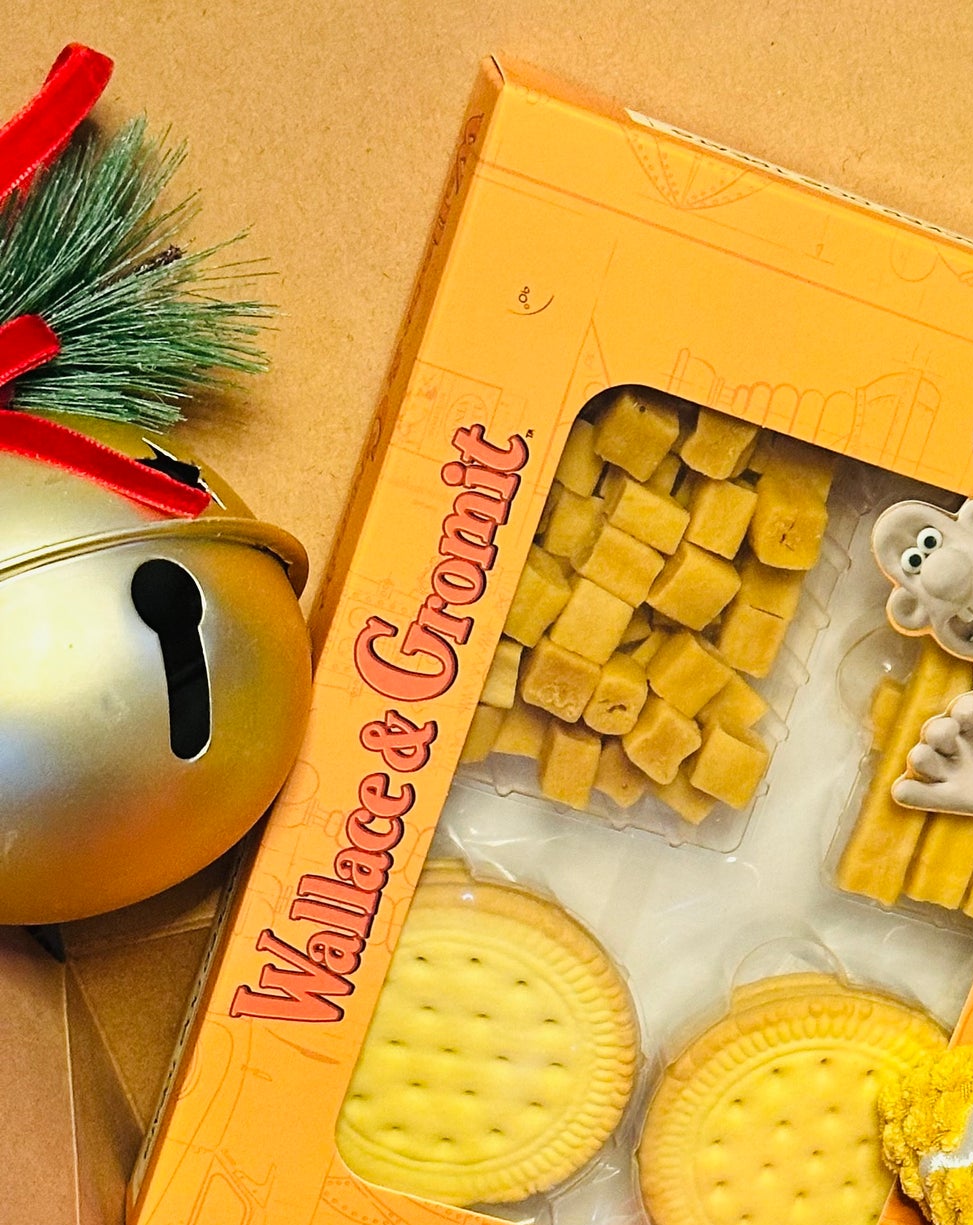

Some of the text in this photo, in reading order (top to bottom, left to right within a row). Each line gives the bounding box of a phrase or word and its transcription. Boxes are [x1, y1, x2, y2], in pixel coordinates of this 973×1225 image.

[353, 423, 530, 702] Gromit
[359, 709, 438, 773] &
[229, 772, 416, 1023] Wallace
